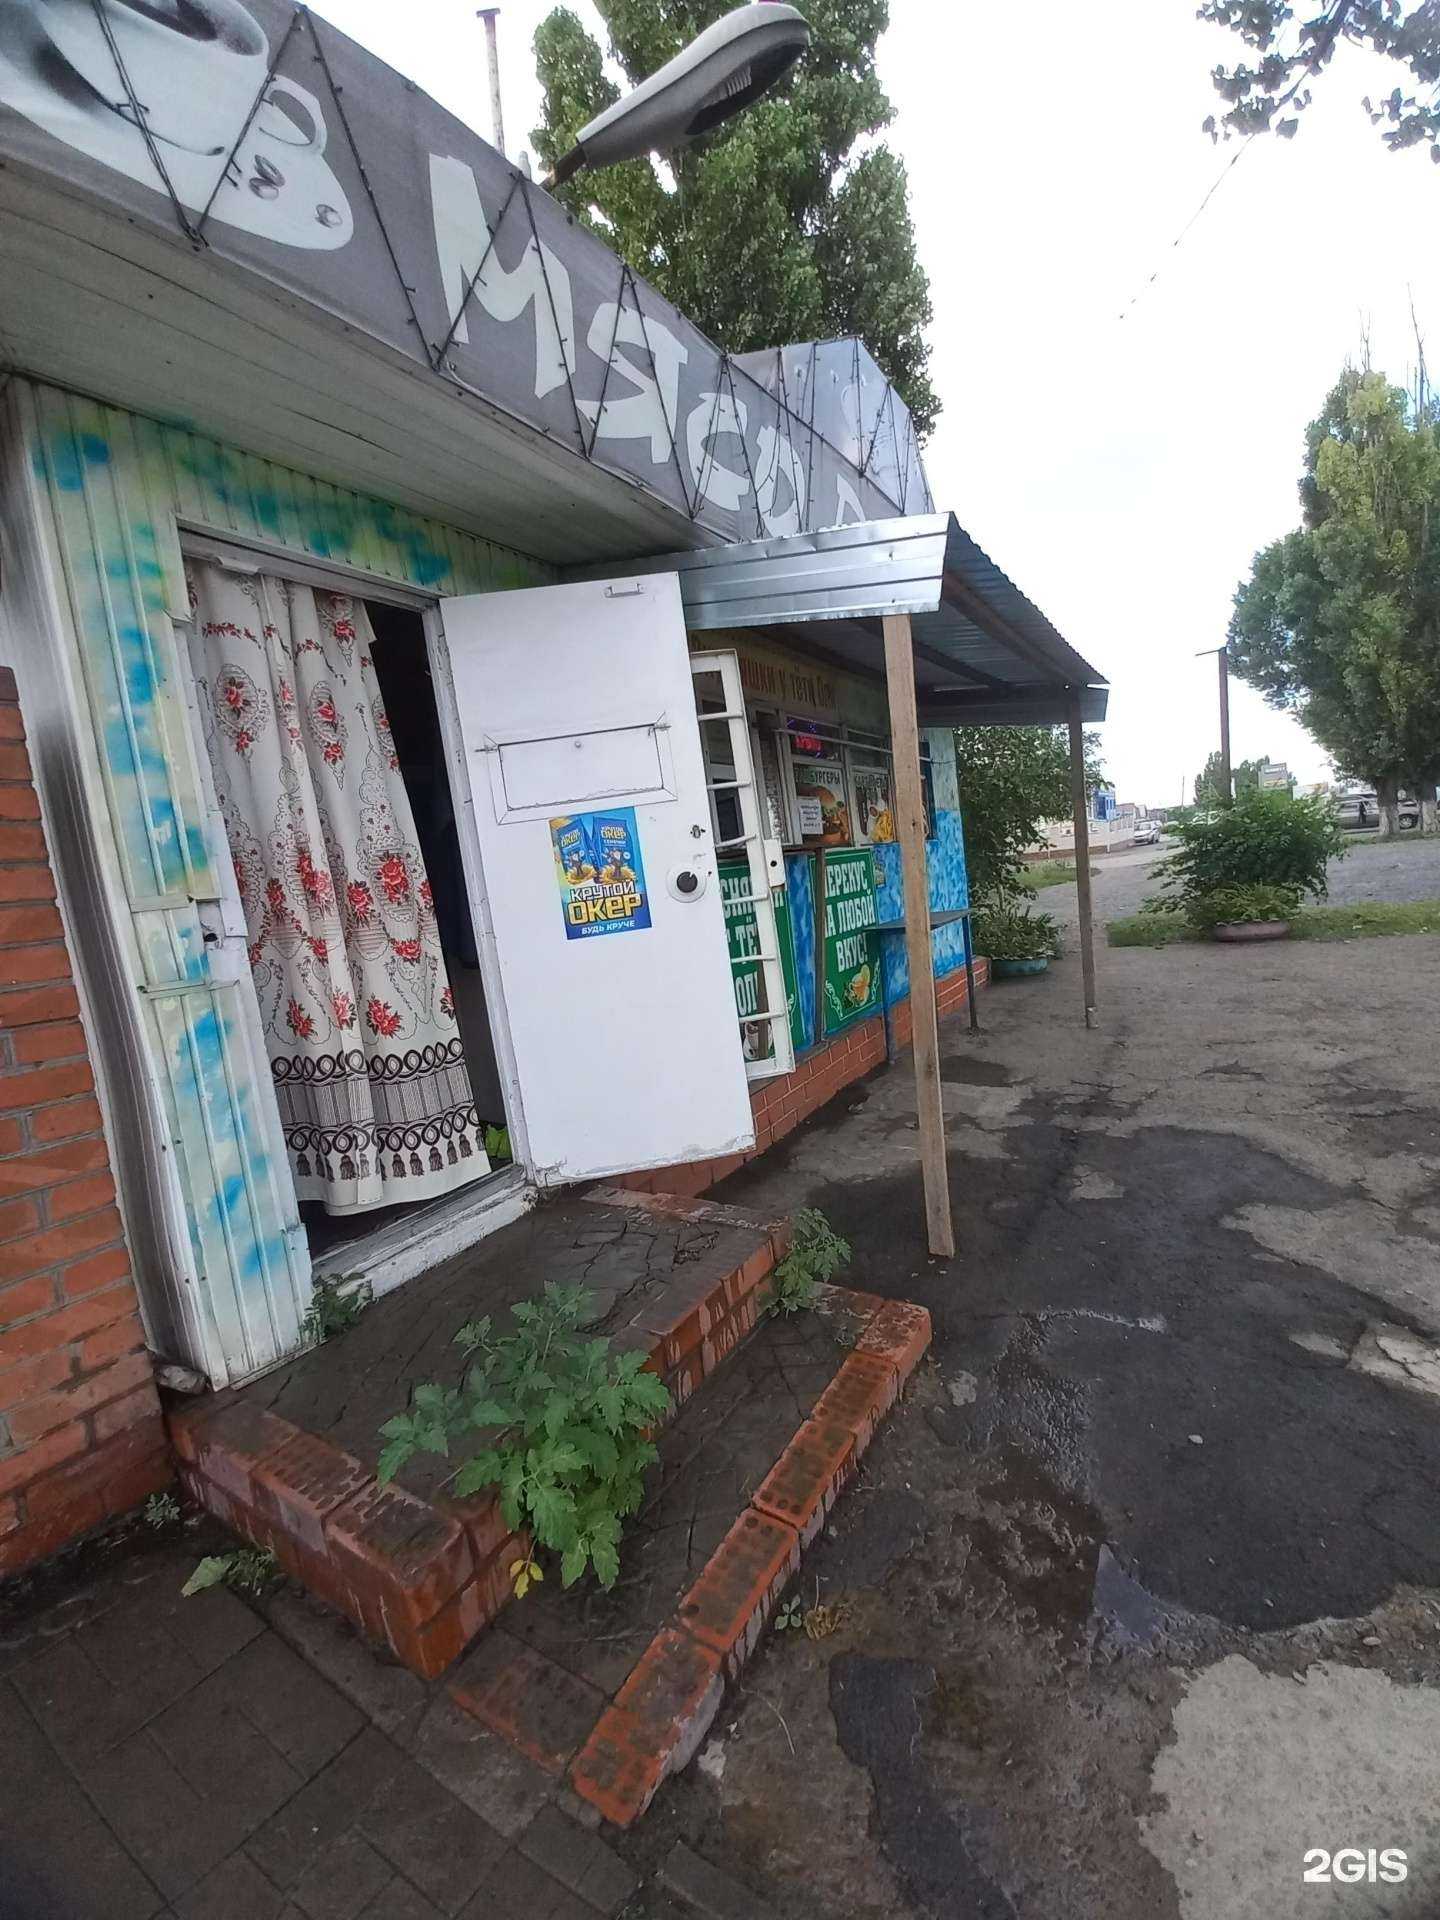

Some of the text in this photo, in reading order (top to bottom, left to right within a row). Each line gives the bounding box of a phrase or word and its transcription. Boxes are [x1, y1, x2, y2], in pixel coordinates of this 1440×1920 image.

[570, 879, 636, 902] КРУТОЙ
[581, 920, 636, 935] БУДЬ КРУЧЕ
[837, 889, 876, 934] ЛЮБОЙ
[836, 932, 868, 973] ВКУС!
